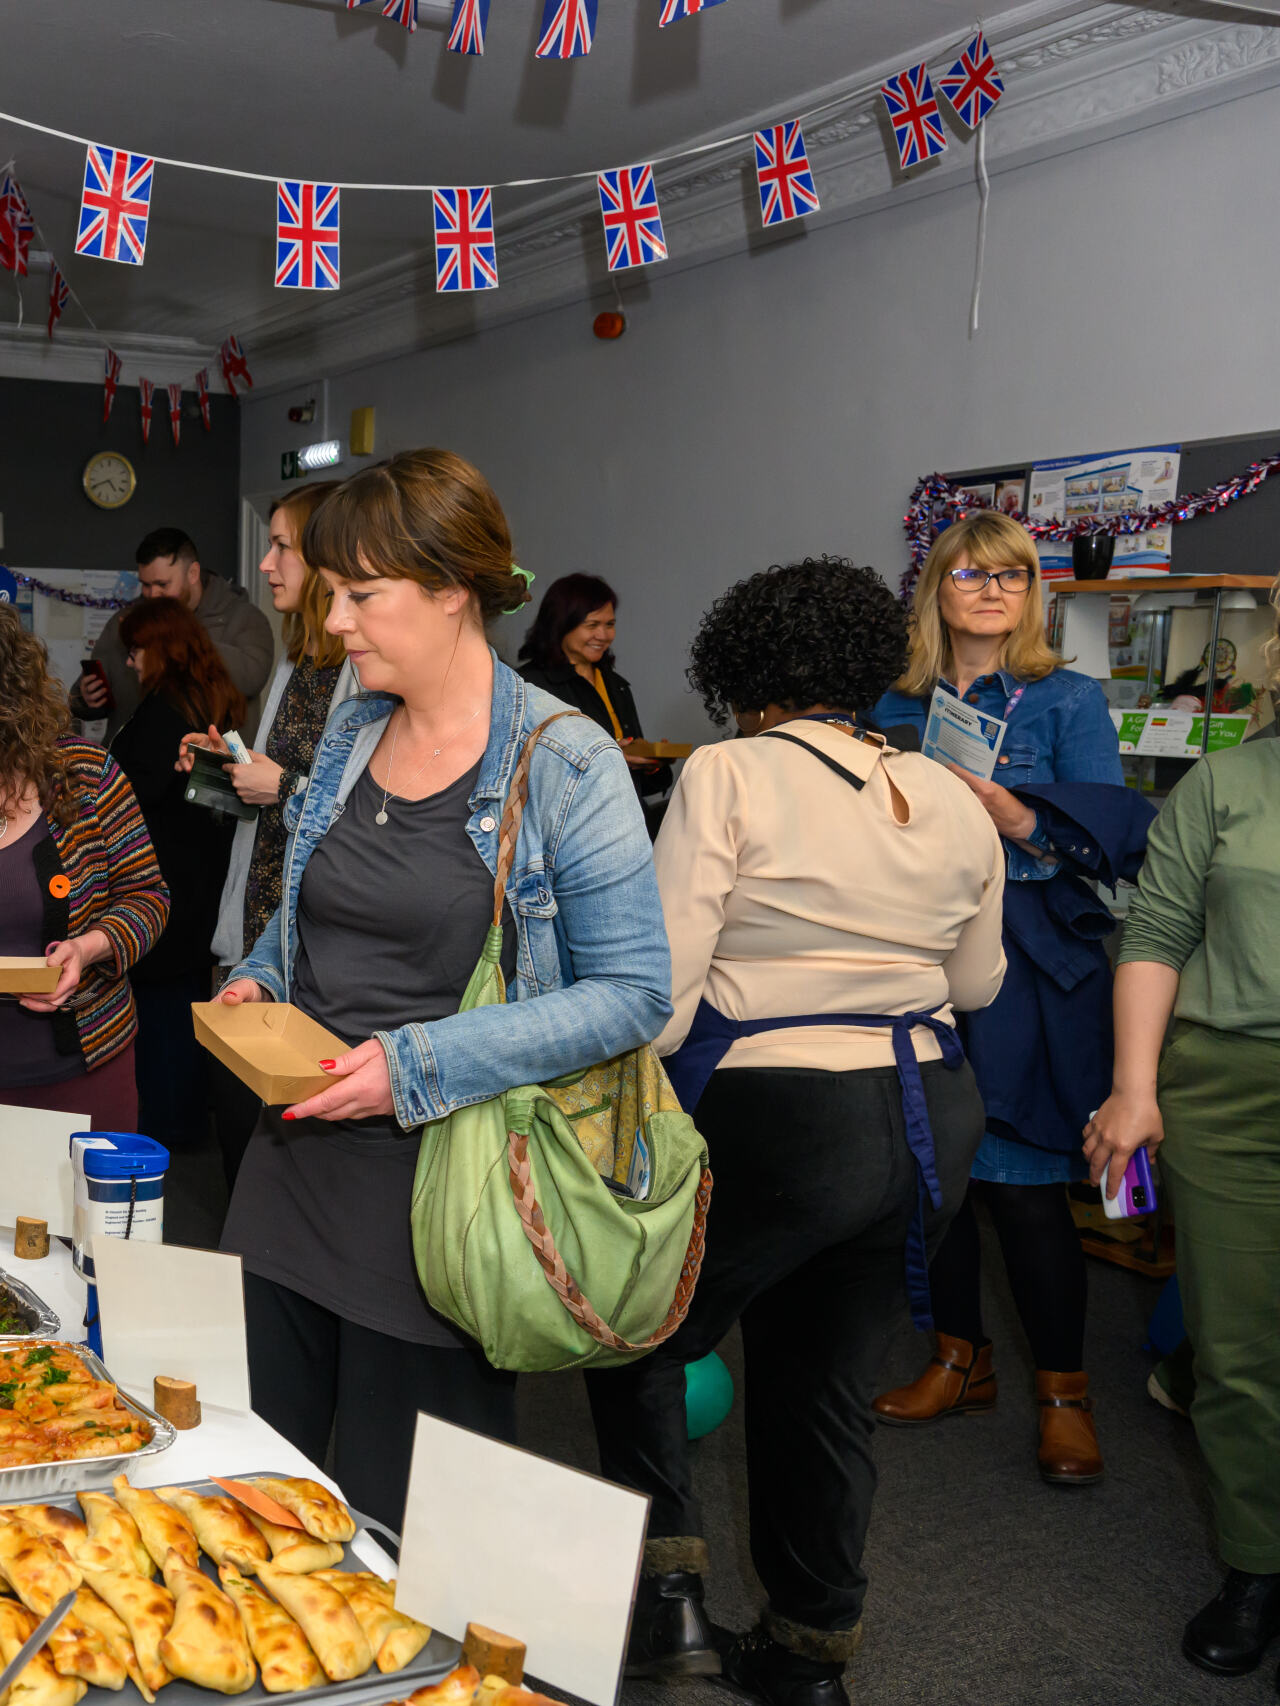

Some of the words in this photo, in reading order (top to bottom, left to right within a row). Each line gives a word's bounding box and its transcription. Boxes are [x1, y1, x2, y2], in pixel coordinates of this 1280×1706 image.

[945, 708, 972, 726] ITINERARY
[1135, 716, 1148, 724] Gif
[1208, 721, 1224, 729] Gift
[1219, 729, 1239, 737] You
